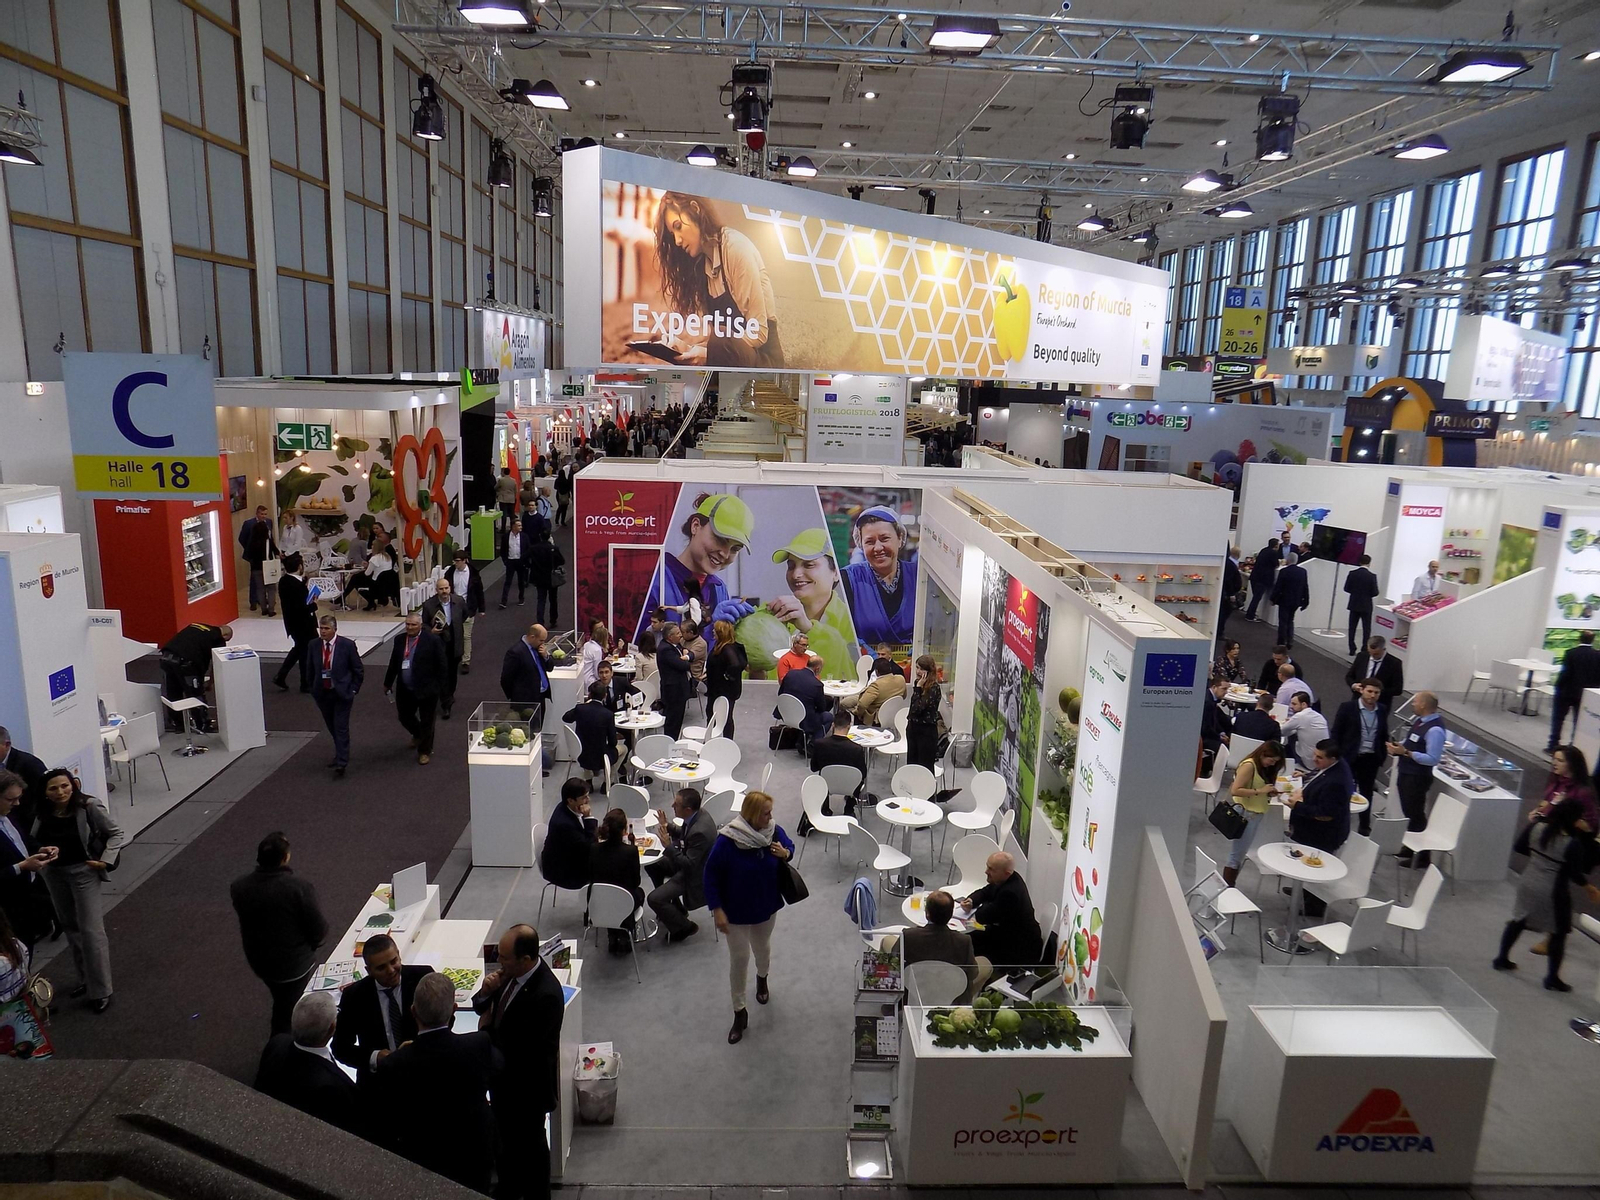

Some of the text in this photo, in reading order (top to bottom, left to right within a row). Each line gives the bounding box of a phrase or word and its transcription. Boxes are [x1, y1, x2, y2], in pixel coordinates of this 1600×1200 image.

[1038, 283, 1132, 317] Region of Murcia
[1229, 295, 1242, 306] 18
[1250, 296, 1261, 307] A
[633, 303, 760, 341] Expertise
[1225, 328, 1235, 337] 26
[511, 328, 530, 355] Aragón
[1223, 341, 1258, 354] 20-26
[513, 349, 536, 370] Alimentos
[1033, 343, 1102, 367] Beyond quality
[112, 371, 175, 449] C
[813, 406, 900, 417] FRUITLOGISTICA 2018
[1433, 415, 1492, 429] PRIMOR
[108, 461, 144, 473] Halle
[110, 475, 132, 487] hall
[151, 462, 190, 489] 18
[115, 505, 151, 513] Primaflor
[1408, 507, 1441, 516] MOYCA
[585, 515, 656, 529] proexport
[54, 571, 62, 579] de
[62, 565, 79, 577] Murcia
[1142, 688, 1173, 696] European
[862, 1108, 883, 1122] kpe
[954, 1127, 1079, 1149] proexport
[1315, 1135, 1436, 1153] APOEXPA
